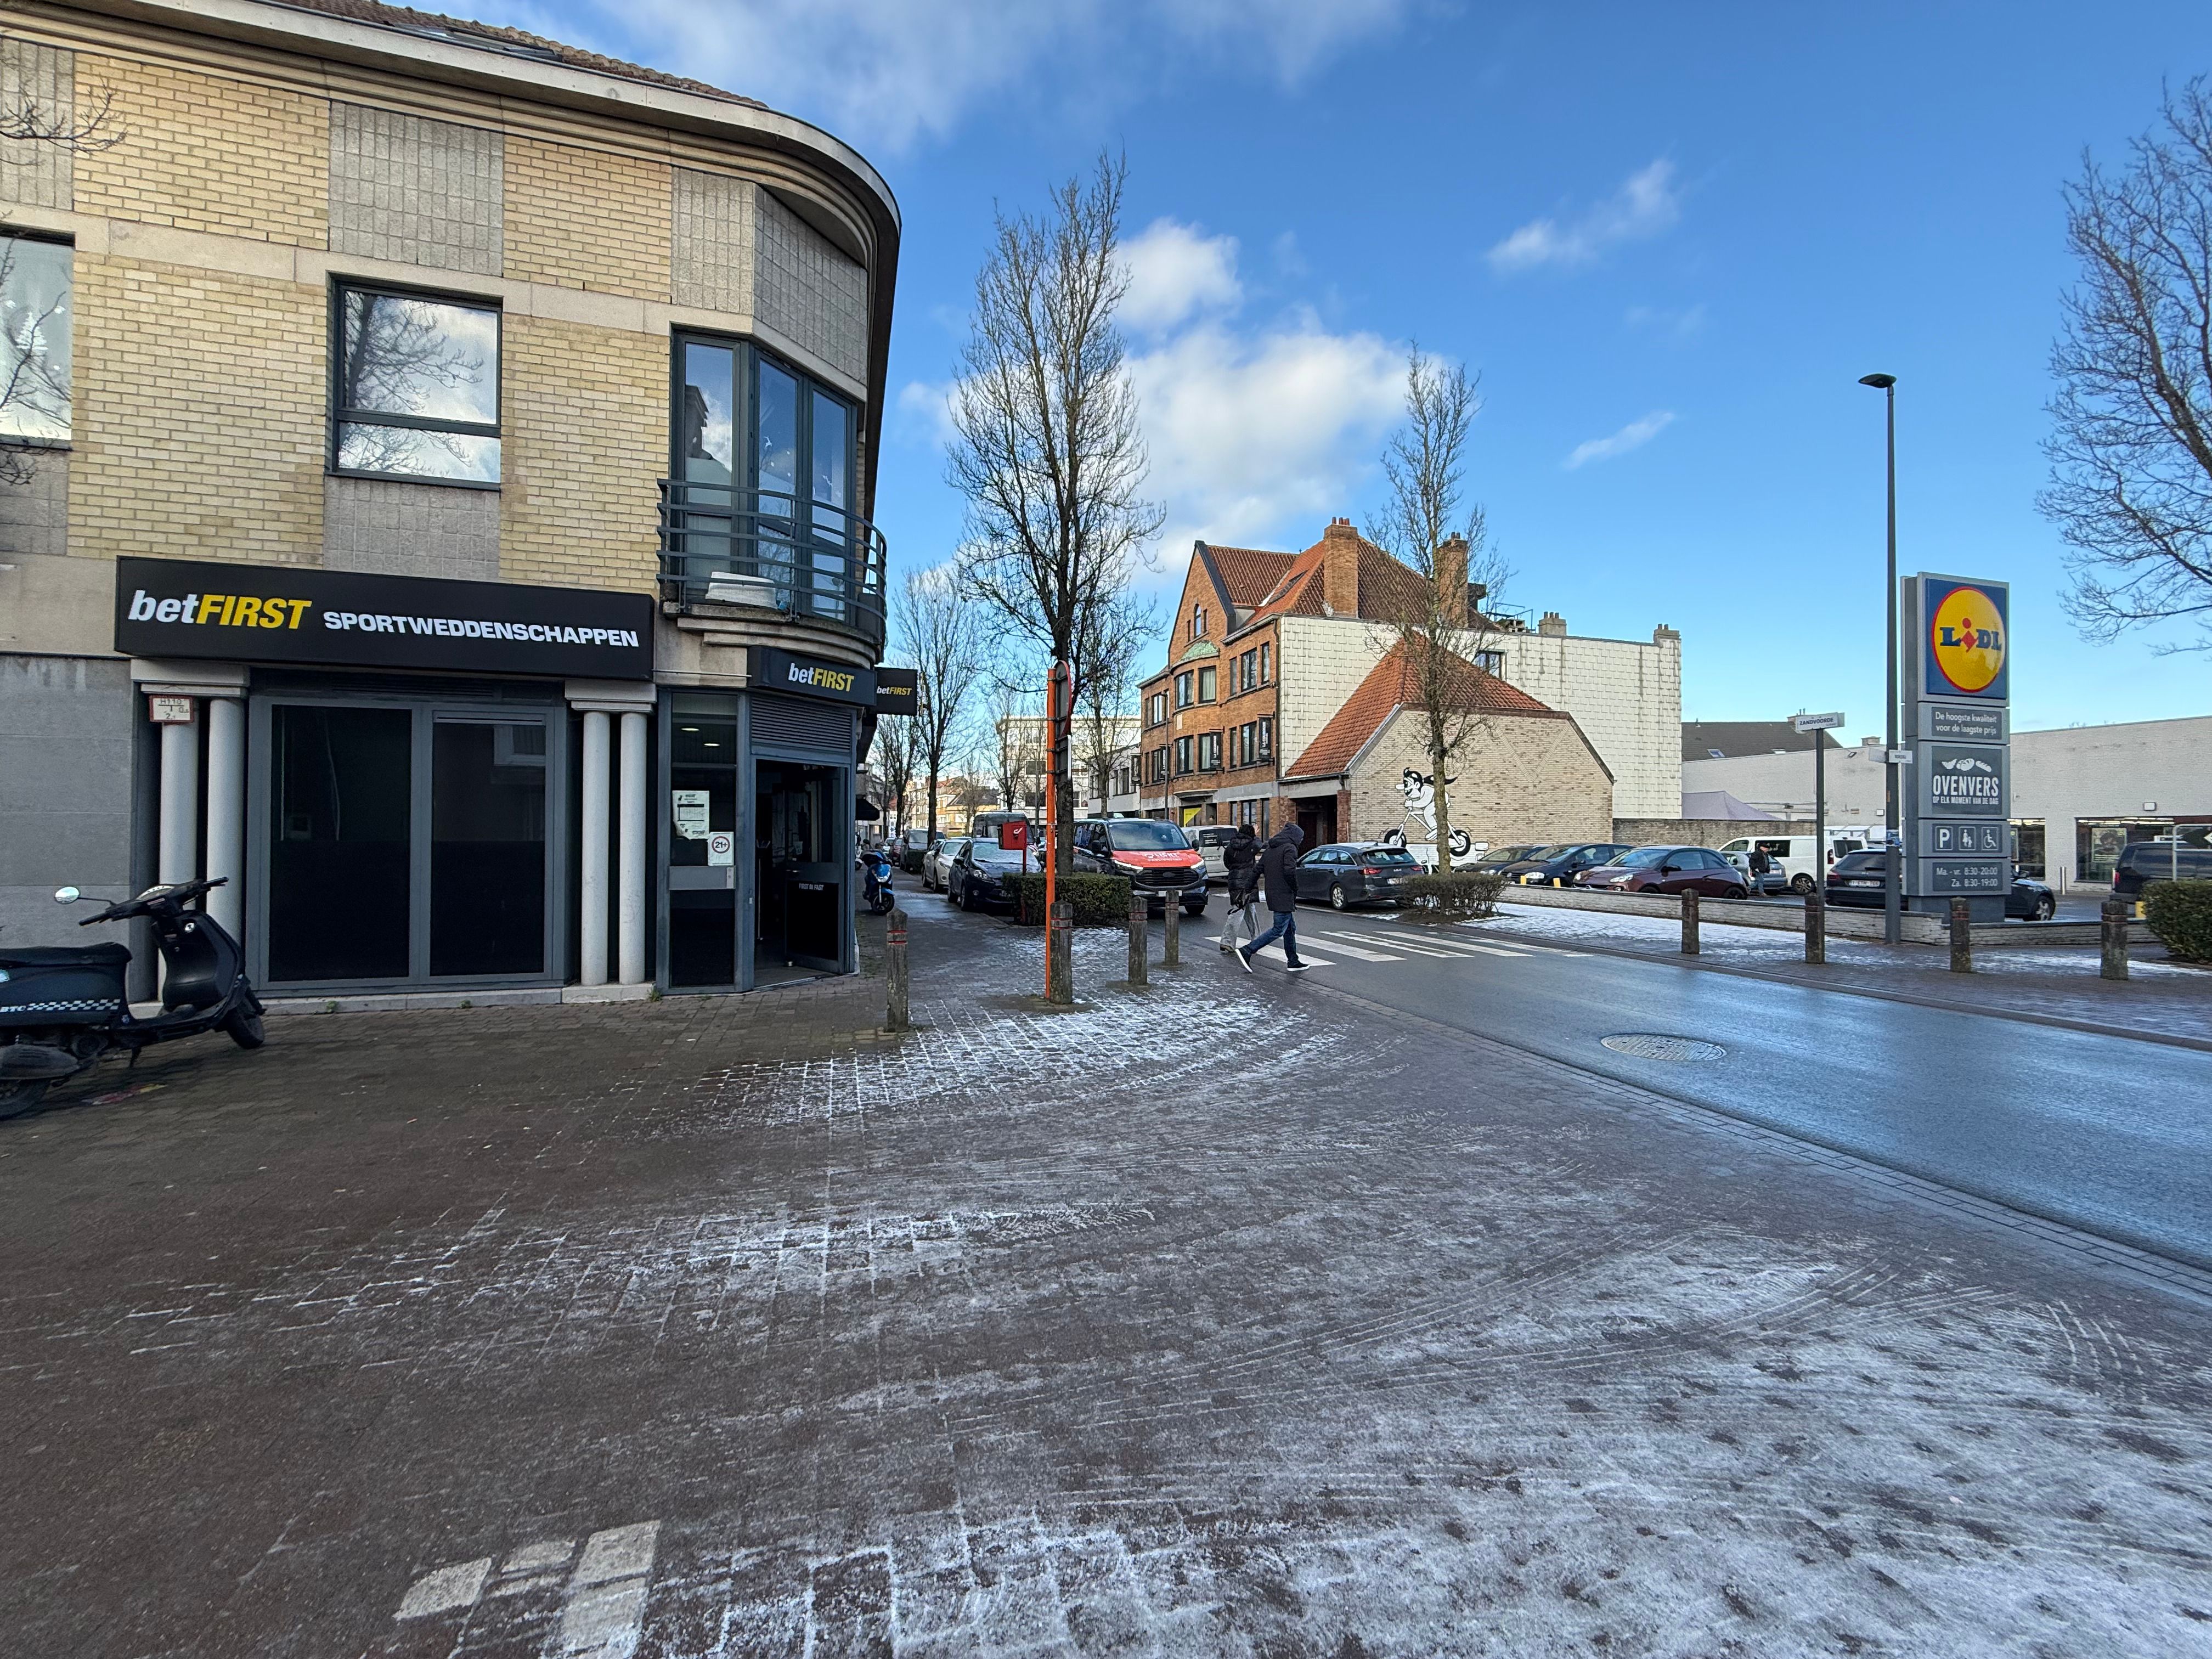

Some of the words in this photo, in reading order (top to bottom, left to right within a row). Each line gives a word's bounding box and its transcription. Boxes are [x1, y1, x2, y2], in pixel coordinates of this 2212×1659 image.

[128, 590, 312, 629] betFIRST
[323, 611, 639, 647] SPORTWEDDENSCHAPPEN
[788, 663, 855, 692] betFIRST
[877, 686, 912, 696] betFIRST
[1936, 712, 1944, 720] De
[1946, 712, 1971, 723] hoogste
[1972, 713, 1997, 723] kwaliteit
[1961, 725, 1983, 735] laagste
[1984, 726, 1996, 735] prijs
[1933, 775, 1999, 797] OVENVERS
[1951, 796, 1972, 804] MOMENT
[1939, 829, 1950, 848] P
